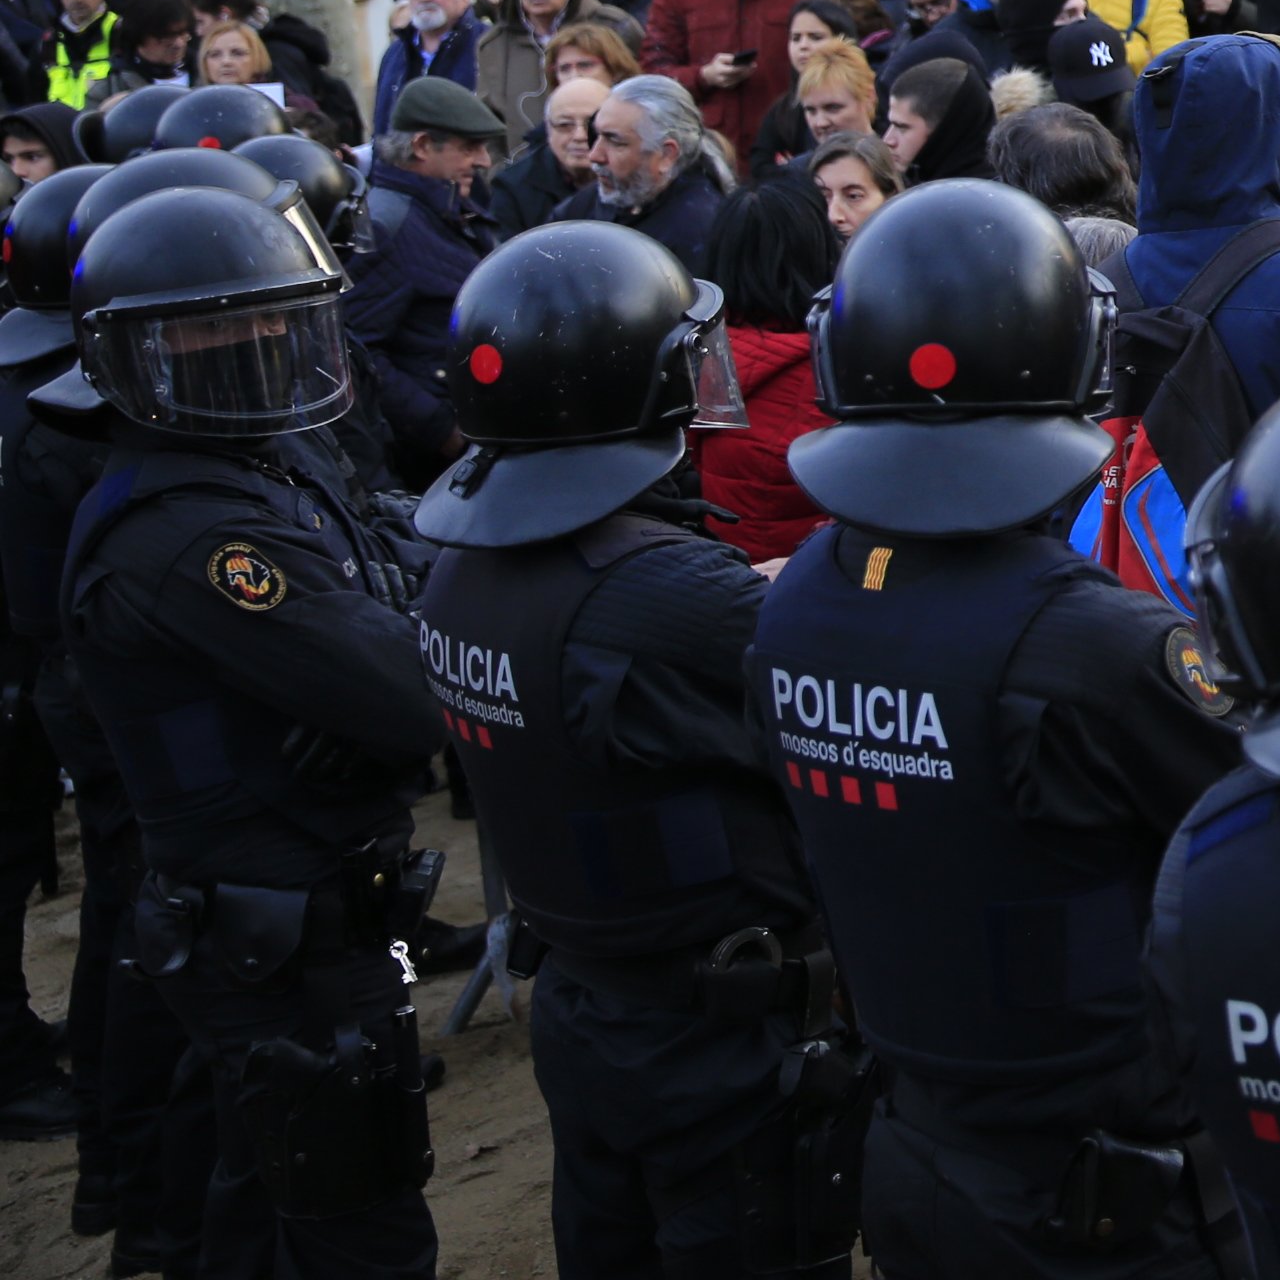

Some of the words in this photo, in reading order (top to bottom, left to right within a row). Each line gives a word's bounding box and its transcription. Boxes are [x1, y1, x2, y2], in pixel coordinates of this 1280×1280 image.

[420, 620, 519, 702] POLICIA
[772, 667, 949, 749] POLICIA
[780, 730, 839, 764] mossos
